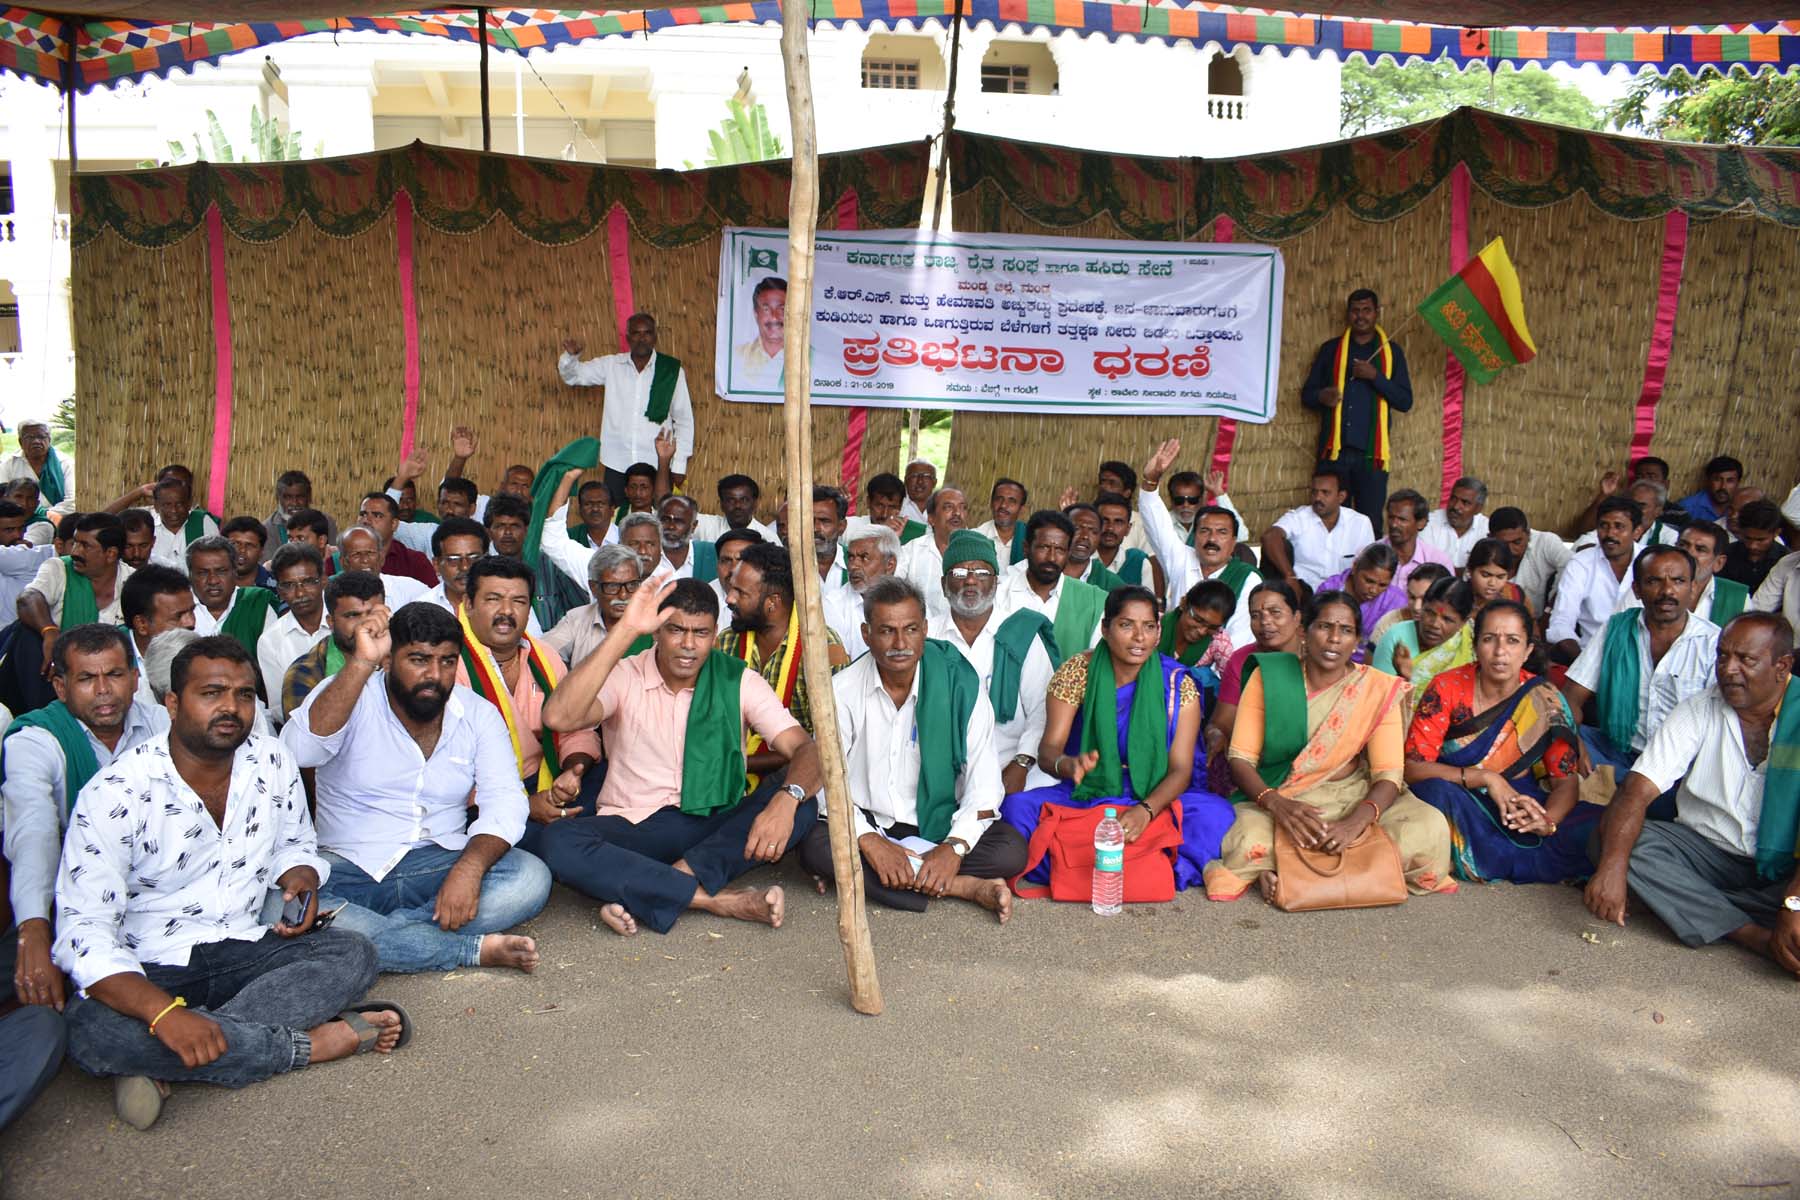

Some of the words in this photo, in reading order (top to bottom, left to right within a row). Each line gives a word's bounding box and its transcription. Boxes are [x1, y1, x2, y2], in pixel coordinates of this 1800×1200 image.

[847, 249, 915, 268] ಕರ್ನಾಟಕ
[924, 253, 959, 273] ರಾಜ್ಯ
[968, 254, 994, 274] ರೈತ
[1003, 256, 1038, 274] ಸಂಘ
[1085, 259, 1129, 275] ಹಸಿರು
[1138, 260, 1172, 276] ಸೇನೆ
[958, 280, 988, 294] ಮಂಡ್ಯ
[900, 293, 930, 310] ಮತ್ತು
[936, 294, 994, 309] ಹೇಮಾವತಿ
[816, 309, 873, 324] ಕುಡಿಯಲು
[880, 313, 917, 326] ಹಾಗೂ
[924, 316, 994, 334] ಒಣಗುತ್ತಿರುವ
[1000, 319, 1051, 334] ಬೆಳೆಗಳಿಗೆ
[1105, 325, 1136, 337] ನೀರು
[843, 331, 1065, 376] ಪ್ರತಿಭಟನಾ
[1093, 344, 1210, 380] ಧರಣಿ
